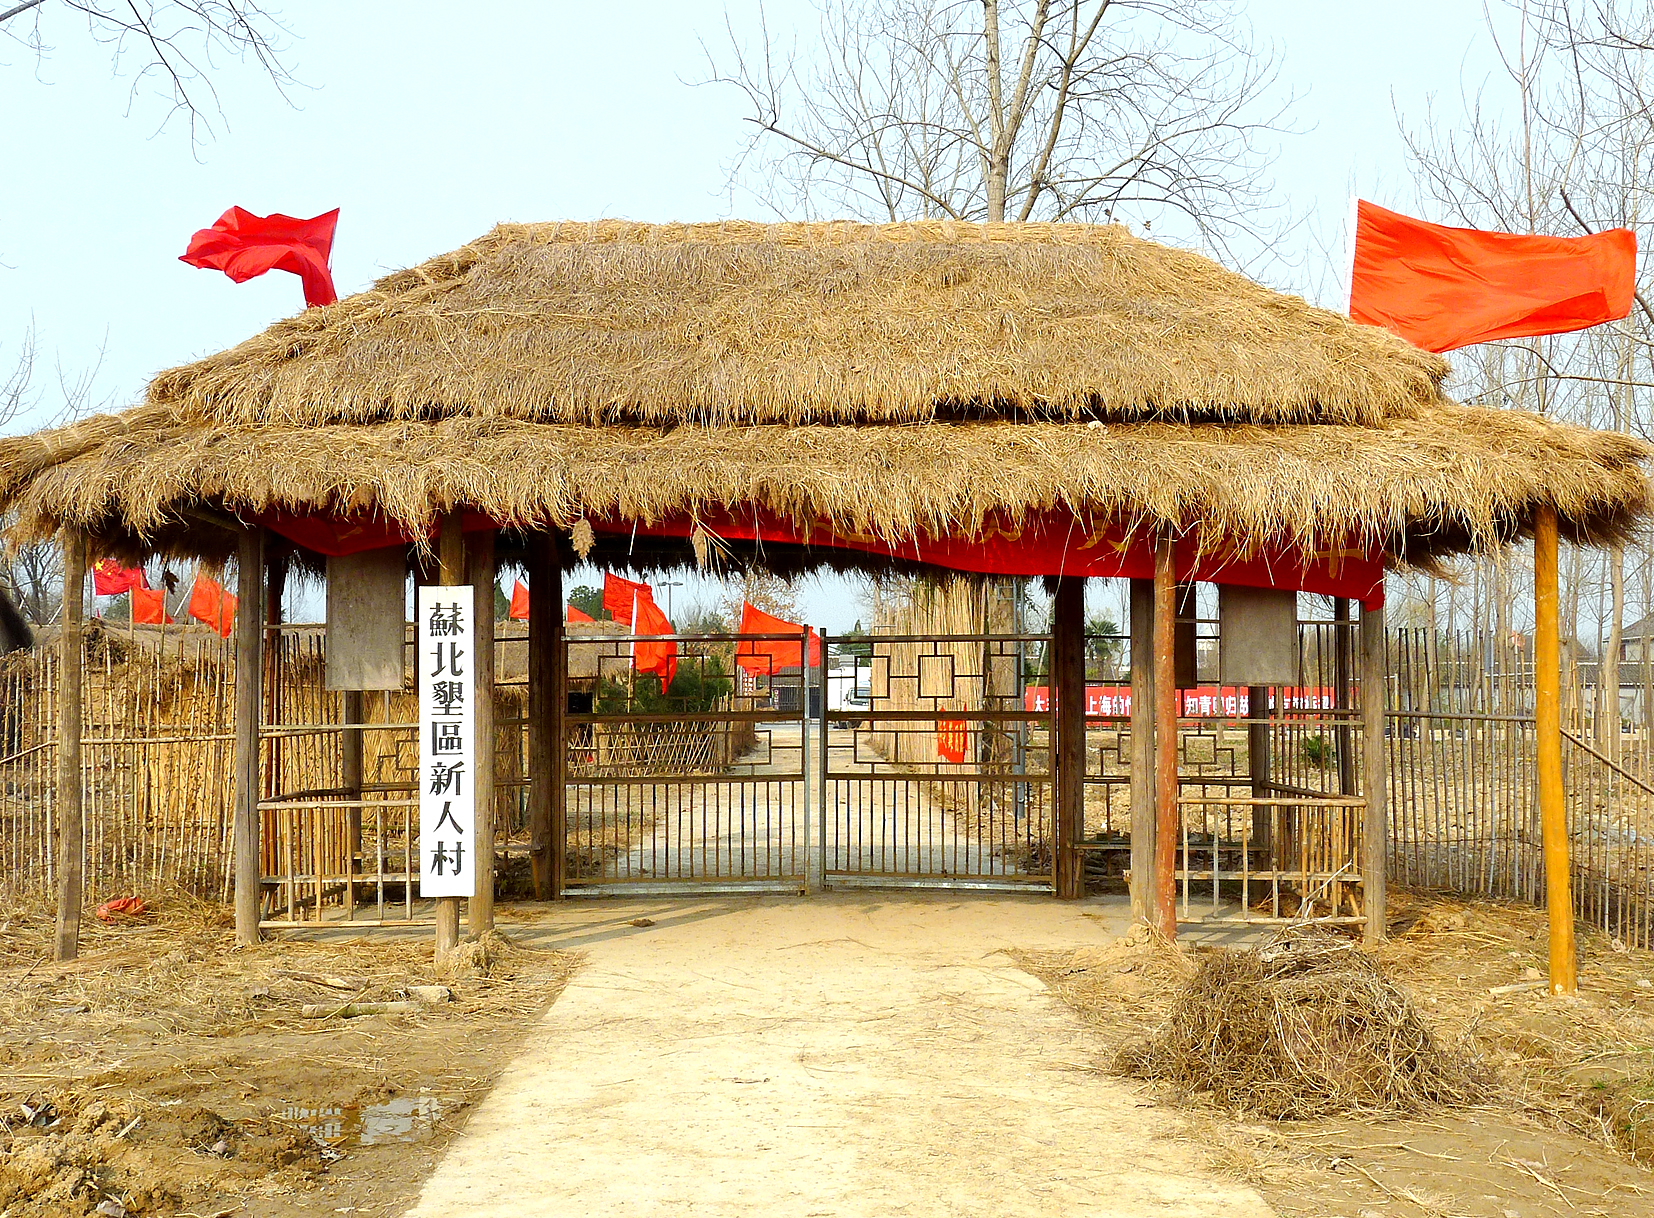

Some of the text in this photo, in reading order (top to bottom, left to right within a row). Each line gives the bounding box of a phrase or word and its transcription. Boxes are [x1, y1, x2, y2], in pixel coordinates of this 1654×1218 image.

[429, 602, 466, 876] 蘇北墾區新人村
